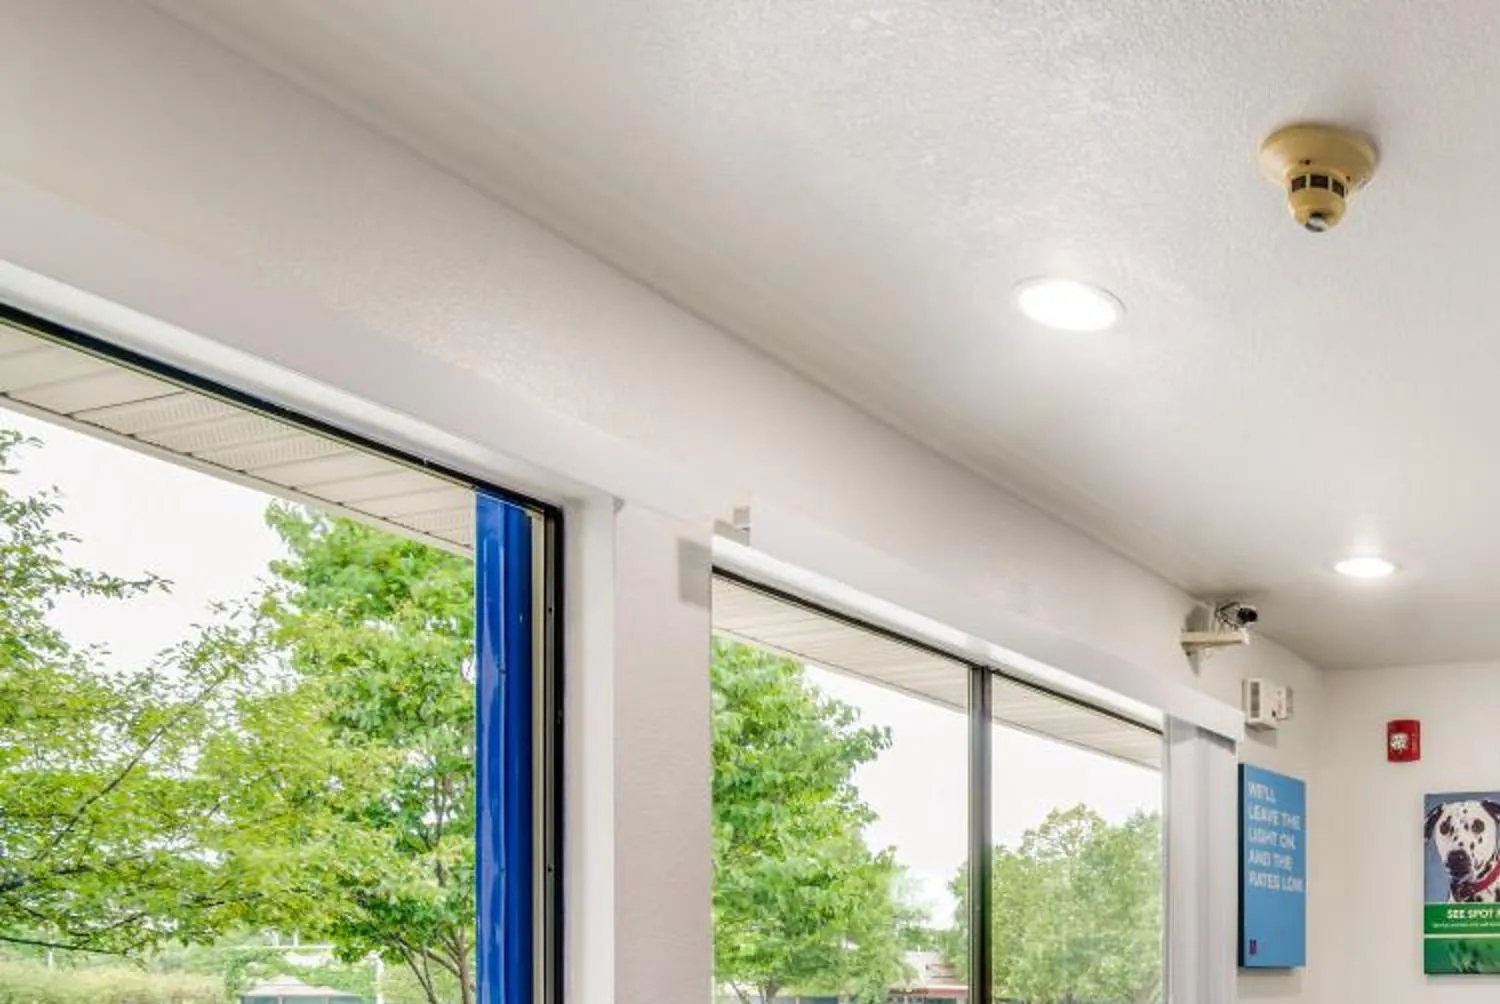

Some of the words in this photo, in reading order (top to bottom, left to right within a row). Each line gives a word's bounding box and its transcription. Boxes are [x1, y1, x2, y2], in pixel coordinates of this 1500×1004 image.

[1248, 803, 1279, 826] LEAVE
[1281, 812, 1301, 830] THE
[1248, 827, 1277, 847] LIGHT
[1248, 849, 1271, 867] AND
[1273, 853, 1293, 870] THE
[1248, 870, 1280, 889] RATES
[1447, 908, 1465, 919] SEE
[1467, 907, 1493, 919] SPOT
